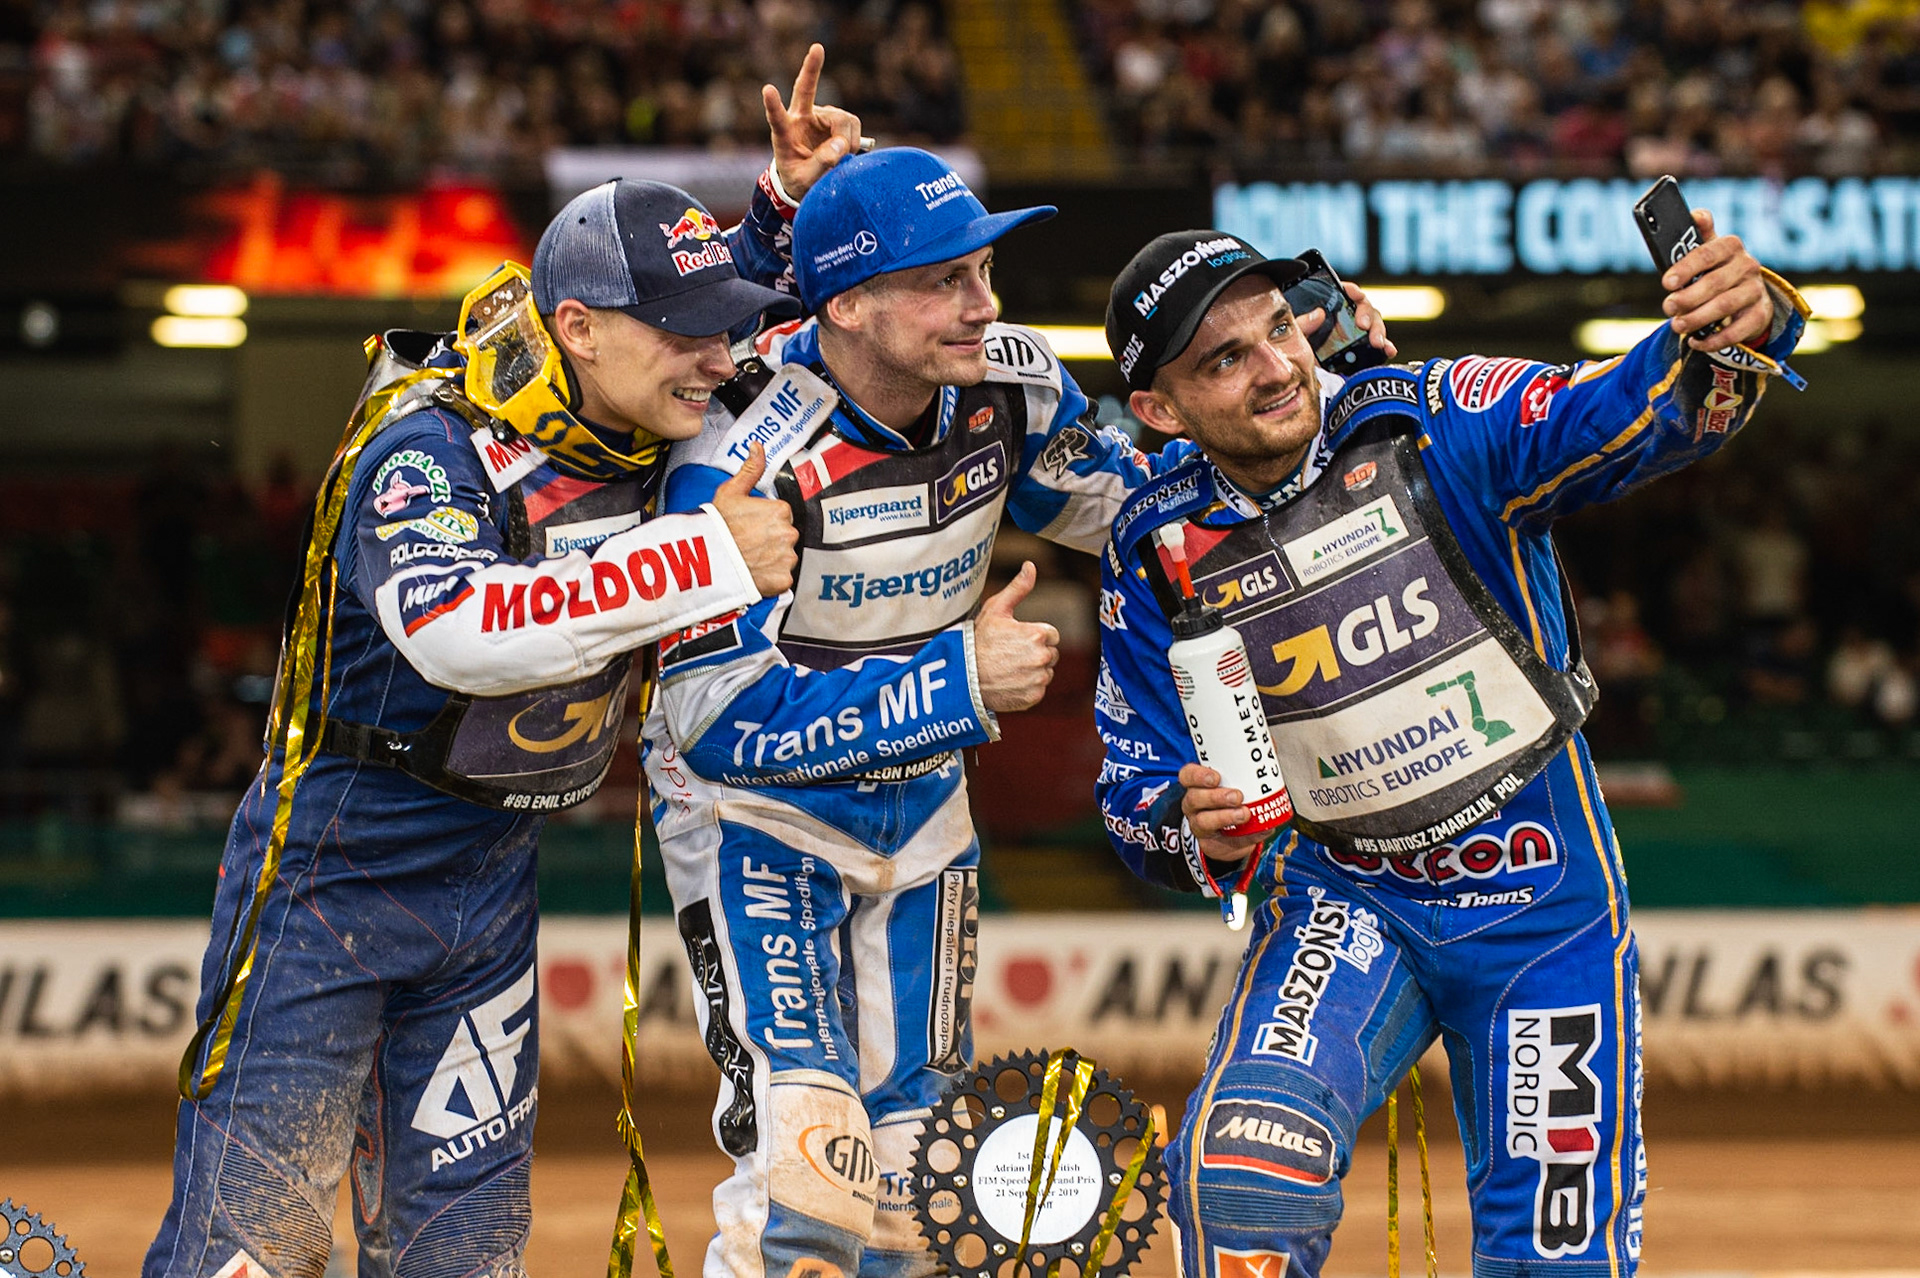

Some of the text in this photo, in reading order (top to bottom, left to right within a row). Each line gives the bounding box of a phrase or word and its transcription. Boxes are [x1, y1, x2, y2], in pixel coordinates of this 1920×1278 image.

[1371, 180, 1502, 275] THE
[672, 241, 734, 276] Red Bu
[770, 379, 802, 421] MF
[790, 397, 825, 436] Spedition
[1328, 379, 1418, 431] GARCAREK
[966, 457, 999, 491] GLS
[829, 496, 922, 524] Kjærgaard
[818, 521, 998, 608] Kjærgaard
[1303, 533, 1382, 578] ROBOTICS EUROPE
[1322, 522, 1377, 555] HYUNDAI
[481, 536, 713, 632] MOLDOW
[1241, 566, 1277, 598] GLS
[1336, 576, 1440, 667] GLS
[733, 658, 947, 767] Trans MF
[1251, 695, 1280, 777] CARGO
[723, 749, 871, 787] Internationale
[875, 715, 975, 758] Spedition
[1233, 693, 1272, 795] PROMET
[1331, 708, 1460, 776] HYUNDAI
[865, 766, 903, 781] LEON
[1309, 739, 1473, 808] ROBOTICS EUROPE
[503, 793, 532, 809] #89
[532, 793, 561, 810] EMIL
[1354, 772, 1525, 854] #95 BARTOSZ ZMARZLIK POL
[946, 873, 960, 905] Płyty
[742, 856, 815, 1051] Trans MF
[793, 856, 839, 1061] Internationale Spedition
[945, 908, 957, 965] niepalne
[1513, 1018, 1541, 1152] NORDIC
[432, 1118, 506, 1172] AUTO
[1017, 1152, 1030, 1160] 1st
[1215, 1117, 1323, 1157] Mitas
[978, 1177, 998, 1185] FIM
[1077, 1176, 1096, 1185] Prix
[993, 1164, 1025, 1173] Adrian
[995, 1188, 1005, 1197] 21
[1058, 1188, 1079, 1197] 2019
